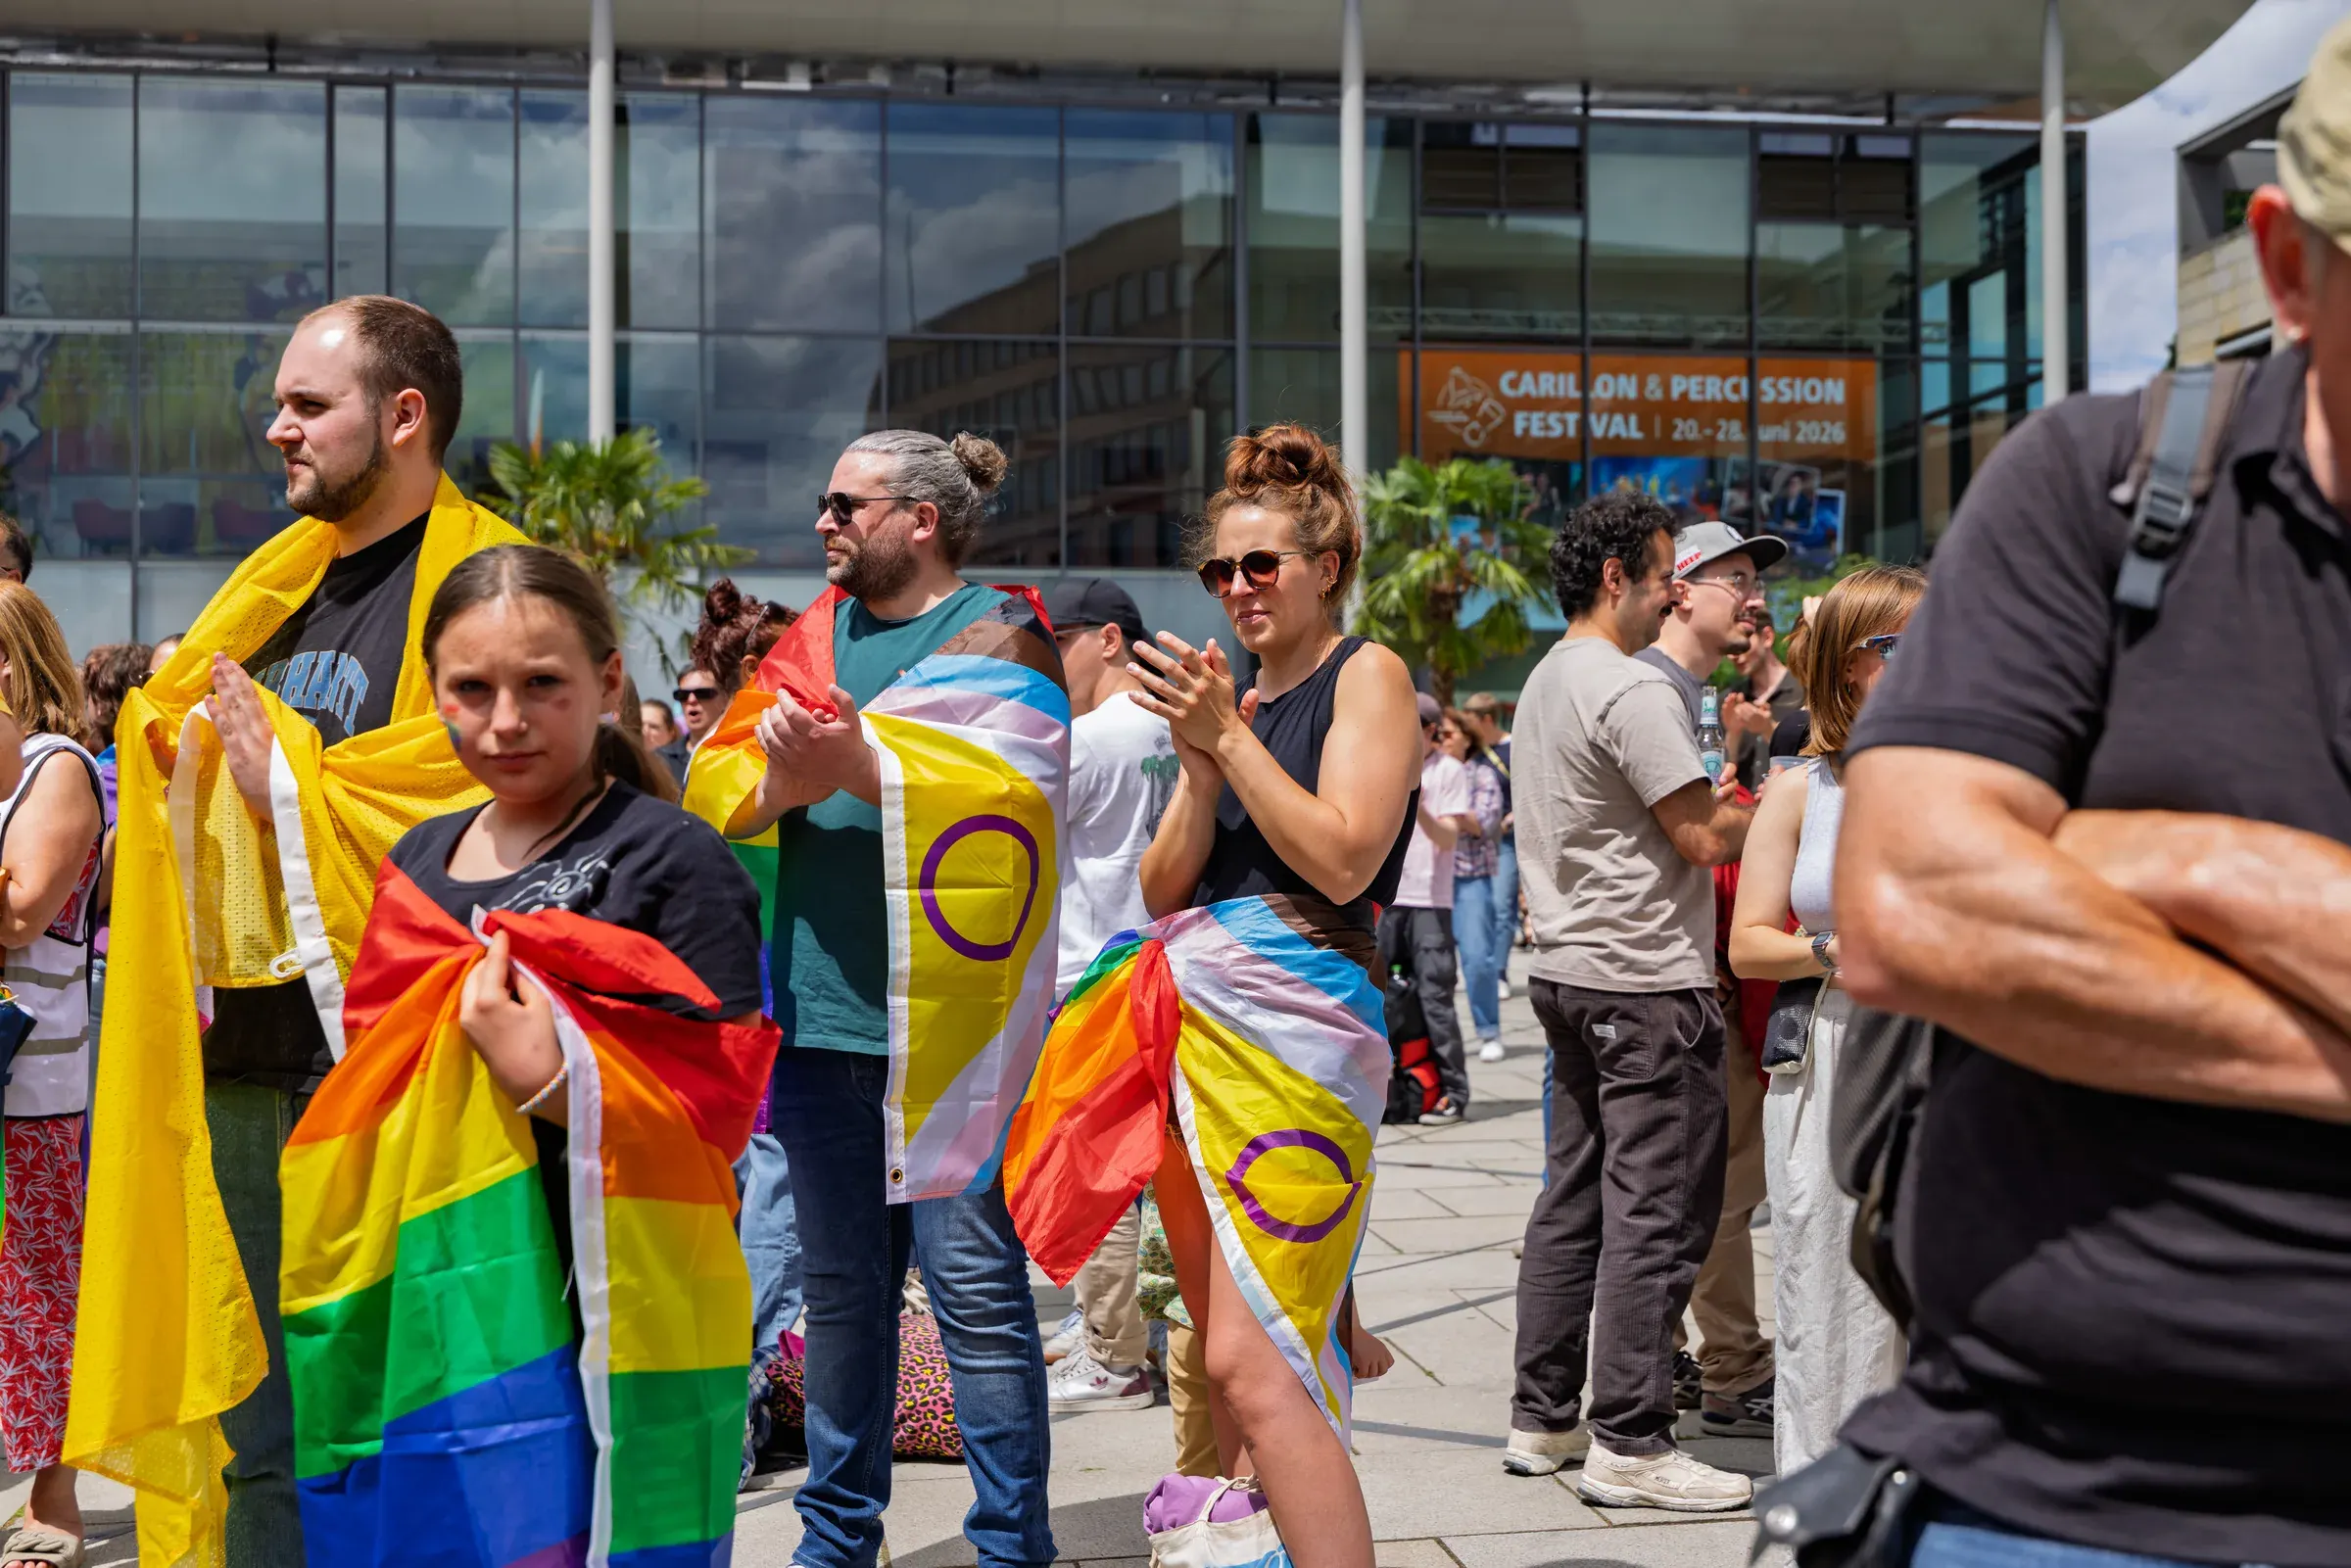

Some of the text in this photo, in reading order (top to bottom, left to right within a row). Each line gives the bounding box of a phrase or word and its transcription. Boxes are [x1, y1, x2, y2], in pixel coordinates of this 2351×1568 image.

[1499, 370, 1638, 400] CARILON
[1644, 373, 1663, 401] &
[1513, 409, 1644, 440] FESTVAL
[1757, 420, 1790, 442] uni
[1796, 421, 1846, 444] 2026
